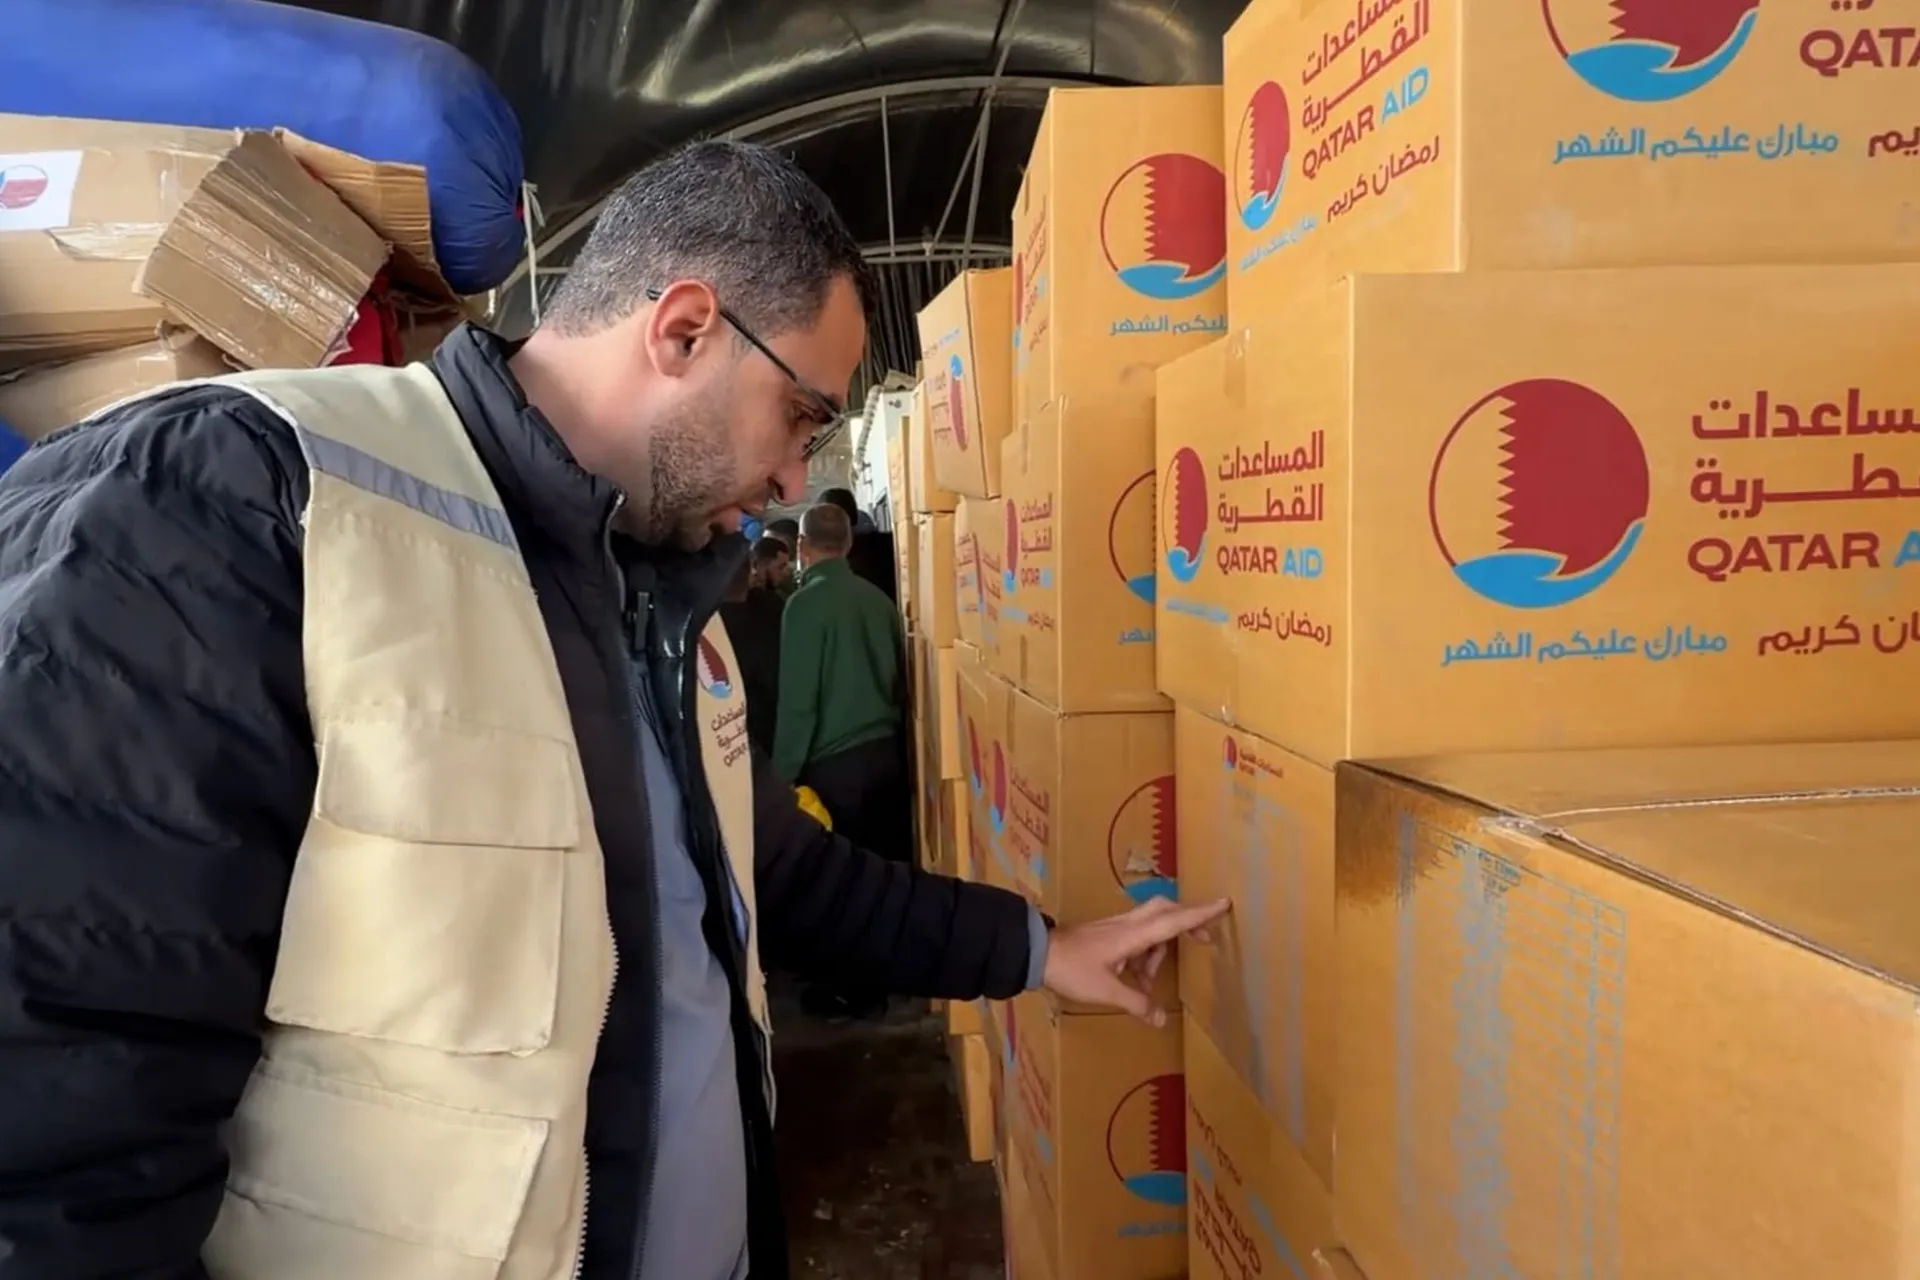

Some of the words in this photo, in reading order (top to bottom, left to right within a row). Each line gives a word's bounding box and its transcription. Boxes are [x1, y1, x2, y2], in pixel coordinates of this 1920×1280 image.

[1302, 0, 1402, 85] ساعدات
[1799, 27, 1920, 77] QAT
[1302, 0, 1429, 134] القطرية
[1302, 104, 1375, 180] QATAR
[1381, 65, 1429, 125] AID
[1552, 127, 1645, 164] الشهر
[1651, 126, 1749, 161] عليكم
[1756, 123, 1838, 160] مبارك
[1372, 135, 1440, 196] رمضان
[1327, 173, 1368, 223] كريم
[1172, 313, 1228, 336] ليكم
[1691, 388, 1920, 440] ساعدات
[1218, 430, 1324, 481] المساعدات
[1217, 483, 1324, 534] القطرية
[1690, 453, 1920, 519] طرية
[1217, 546, 1278, 575] QATAR
[1283, 548, 1323, 577] AID
[1687, 532, 1880, 582] QATAR
[1238, 607, 1272, 632] كريم
[1276, 610, 1332, 647] رمضان
[1757, 614, 1860, 656] كريم
[1440, 631, 1532, 667] الشهر
[1537, 628, 1637, 663] عليكم
[1644, 625, 1727, 661] مبارك
